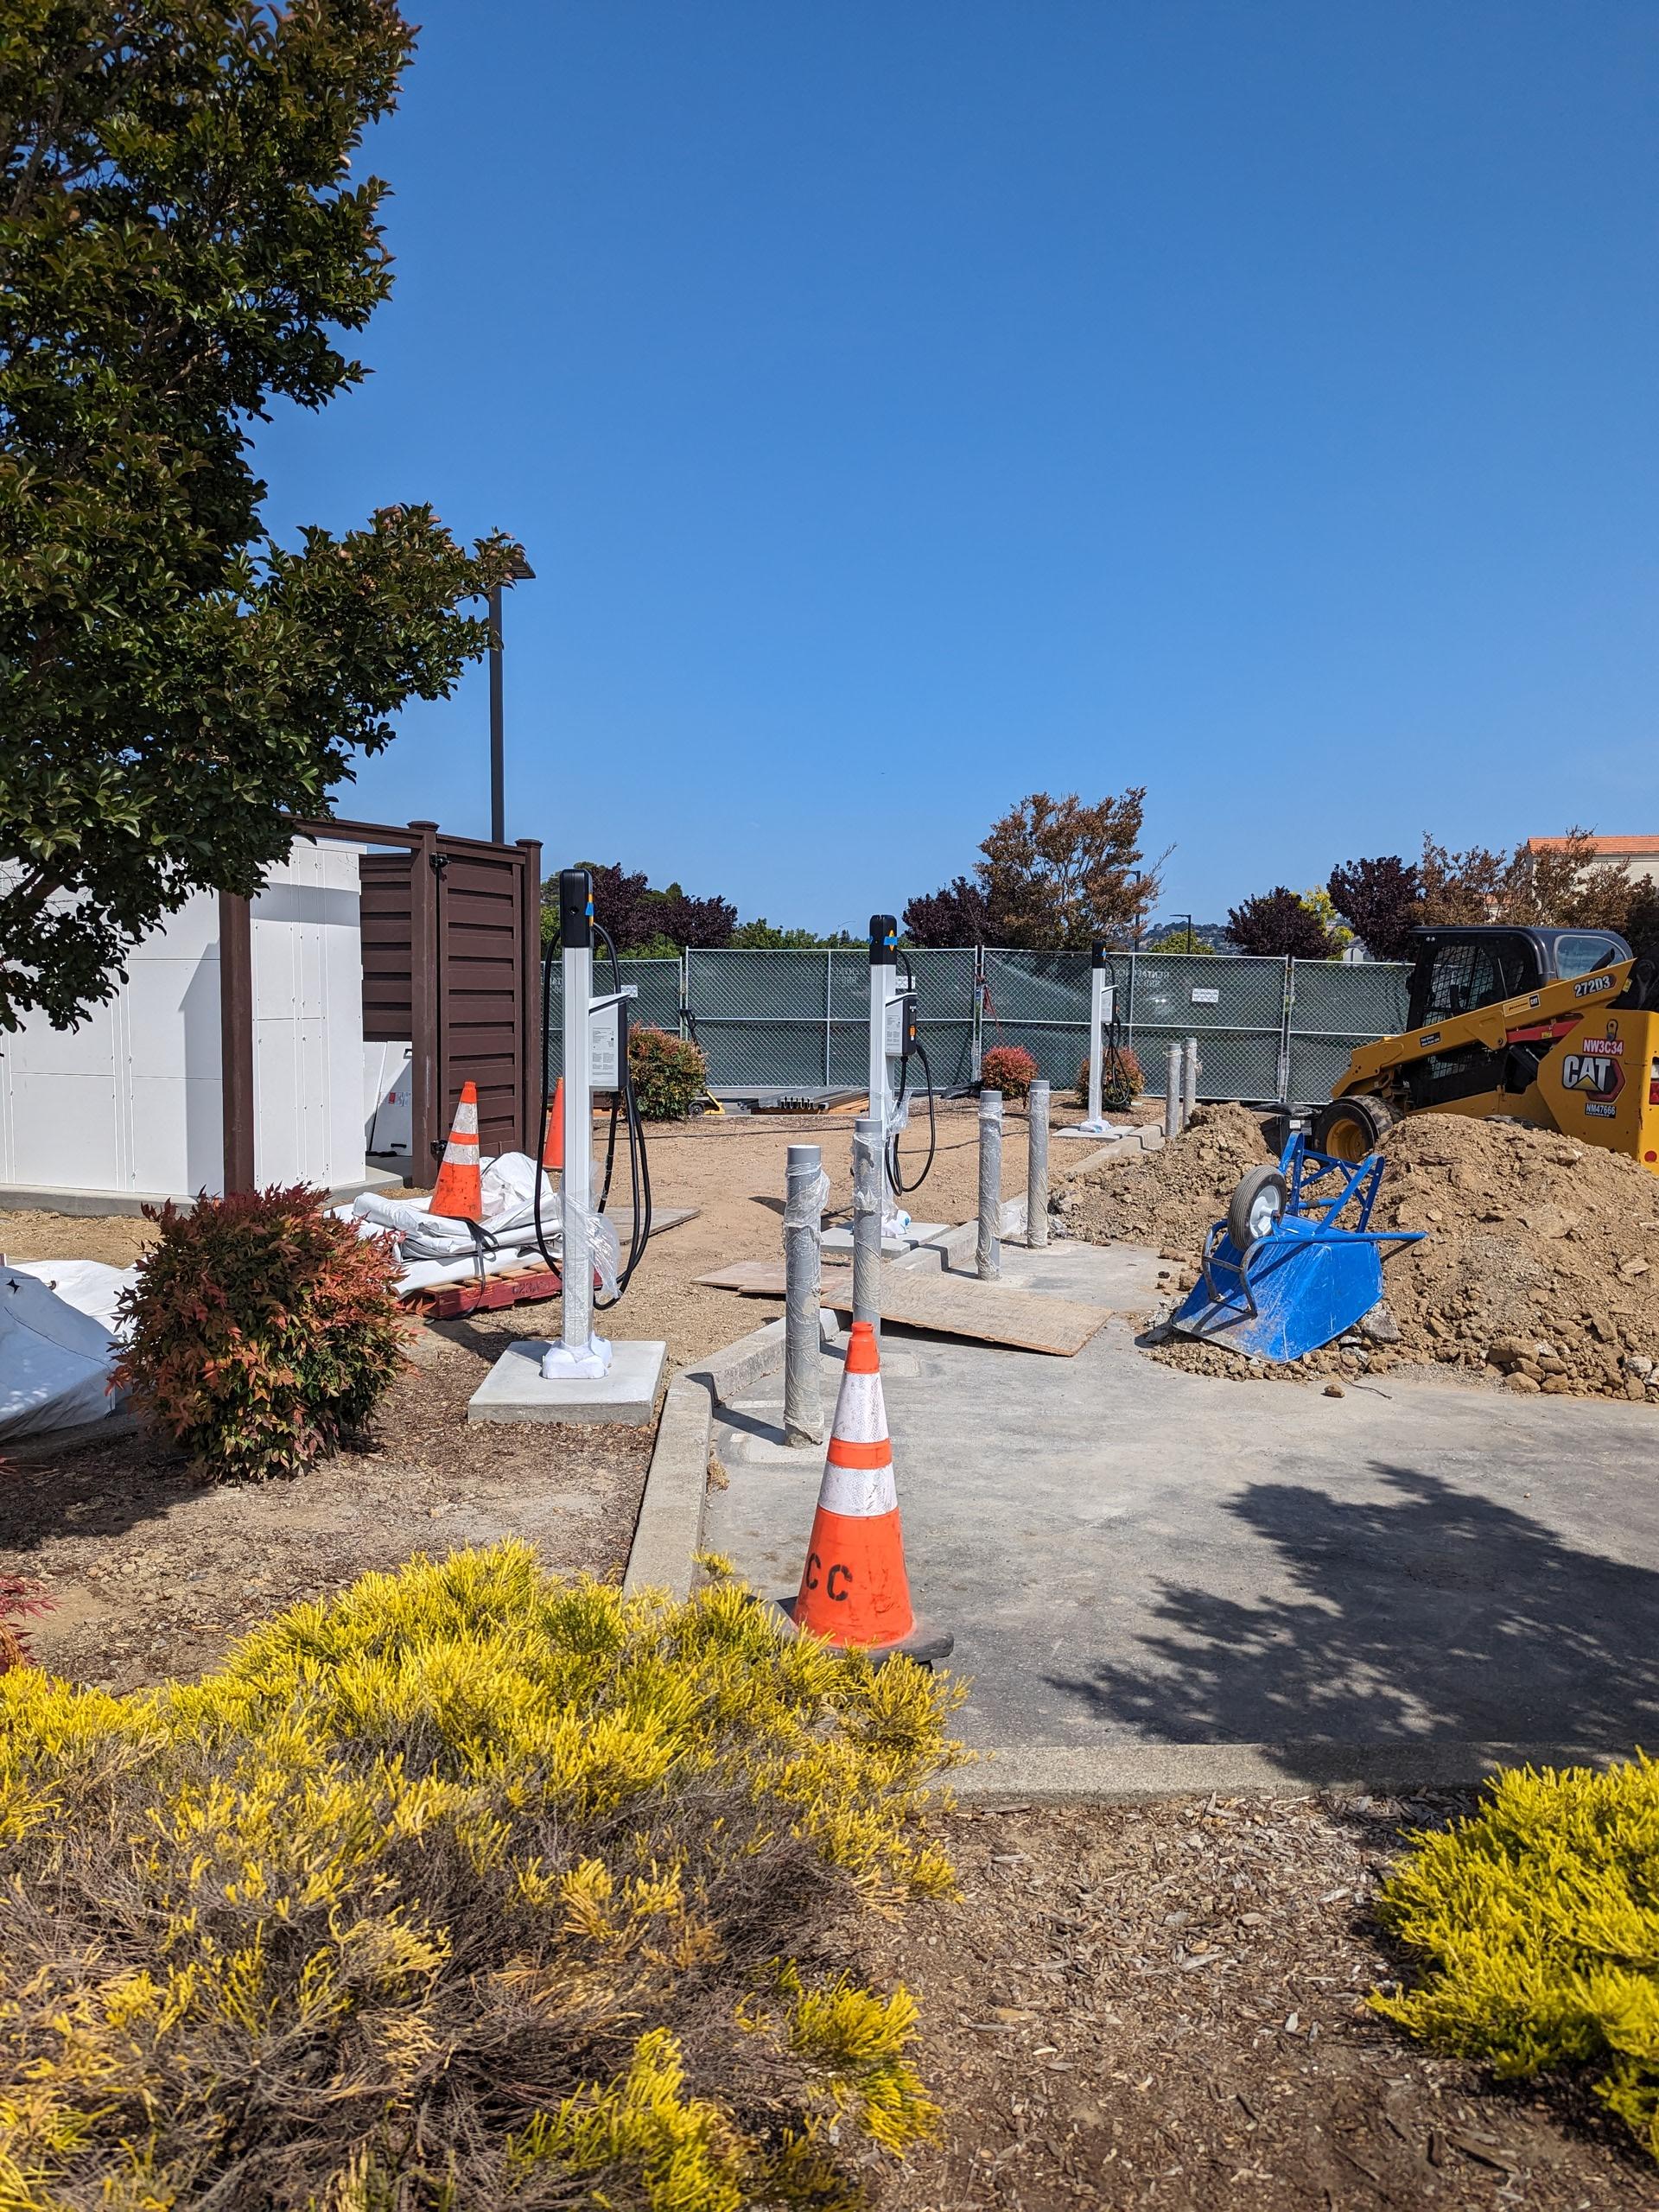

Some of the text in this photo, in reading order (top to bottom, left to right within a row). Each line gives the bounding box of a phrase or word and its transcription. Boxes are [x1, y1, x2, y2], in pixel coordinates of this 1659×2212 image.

[1574, 976, 1611, 997] 272D3
[1583, 1039, 1624, 1055] NW3C34
[1562, 1055, 1611, 1091] CAT
[1586, 1103, 1616, 1116] NM47666
